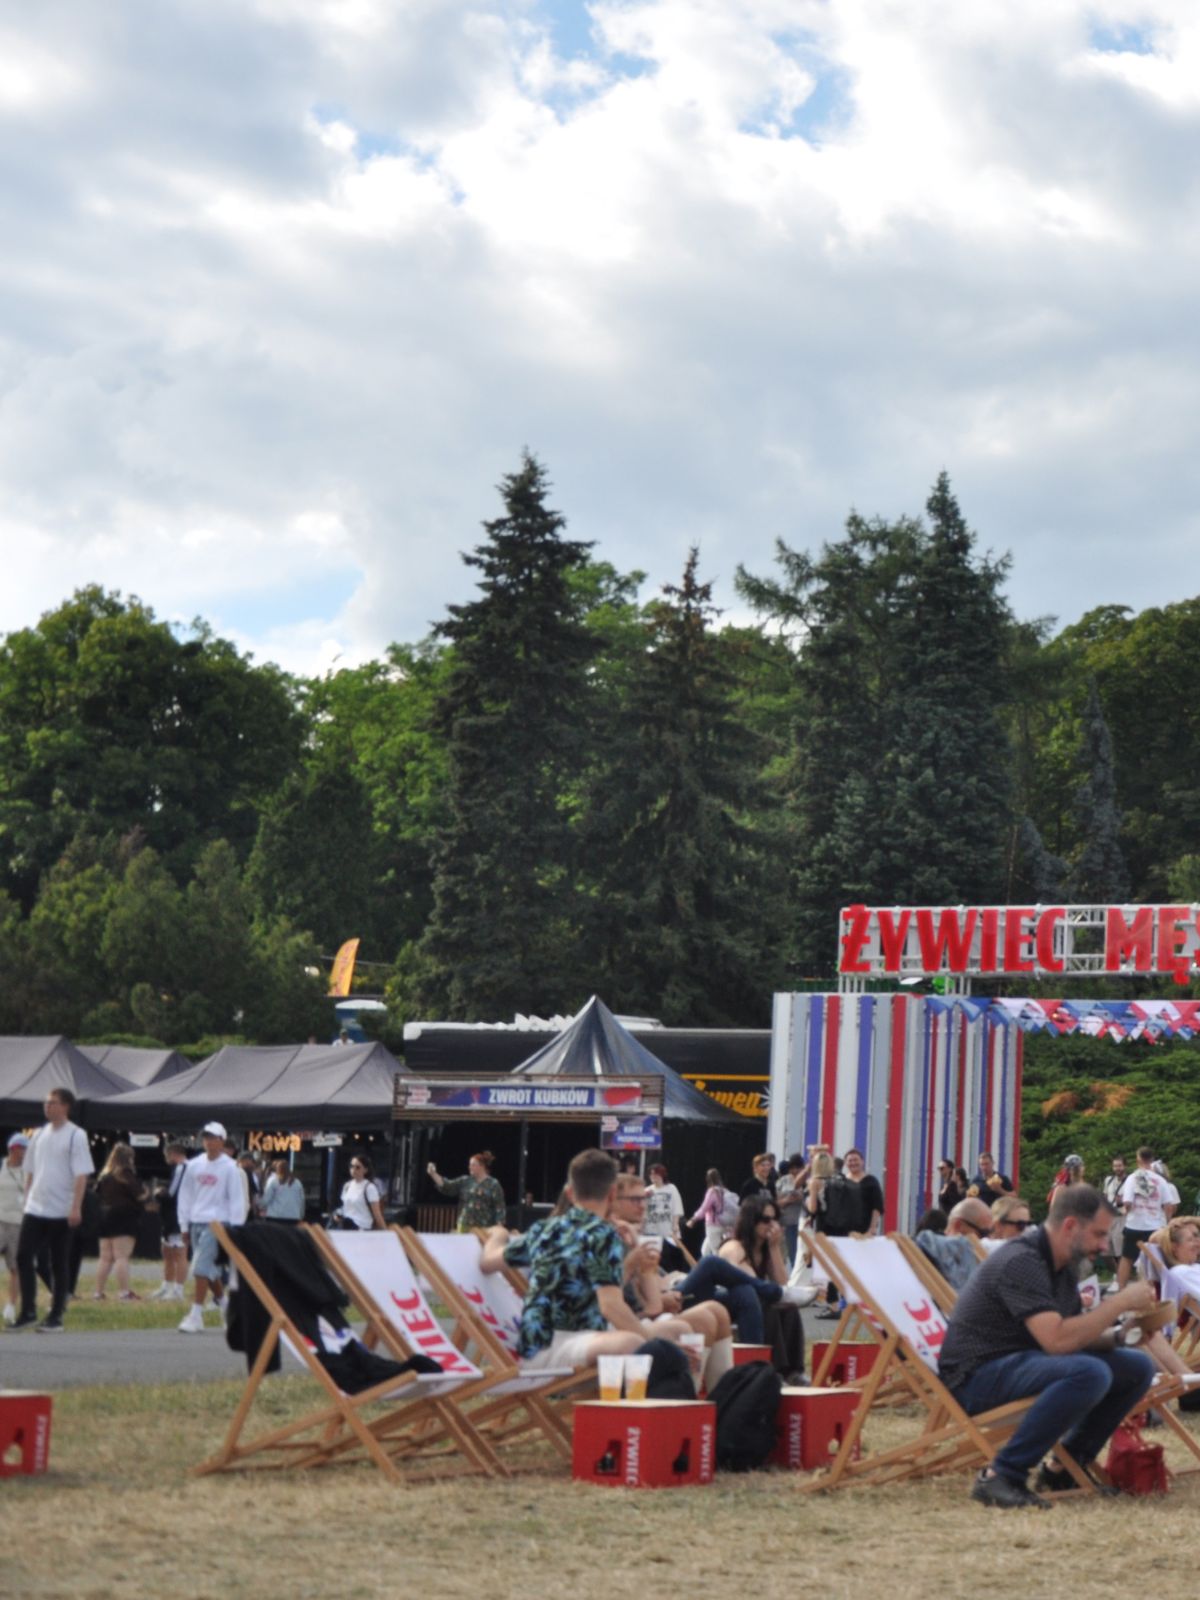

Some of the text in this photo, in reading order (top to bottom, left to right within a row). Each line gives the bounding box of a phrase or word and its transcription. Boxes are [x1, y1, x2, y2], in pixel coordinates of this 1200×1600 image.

[840, 904, 1066, 973] ŻYWIEC
[489, 1087, 589, 1104] ZWROT KUBKÓW
[249, 1131, 301, 1152] Kawa
[626, 1427, 640, 1486] ŻYWIEC
